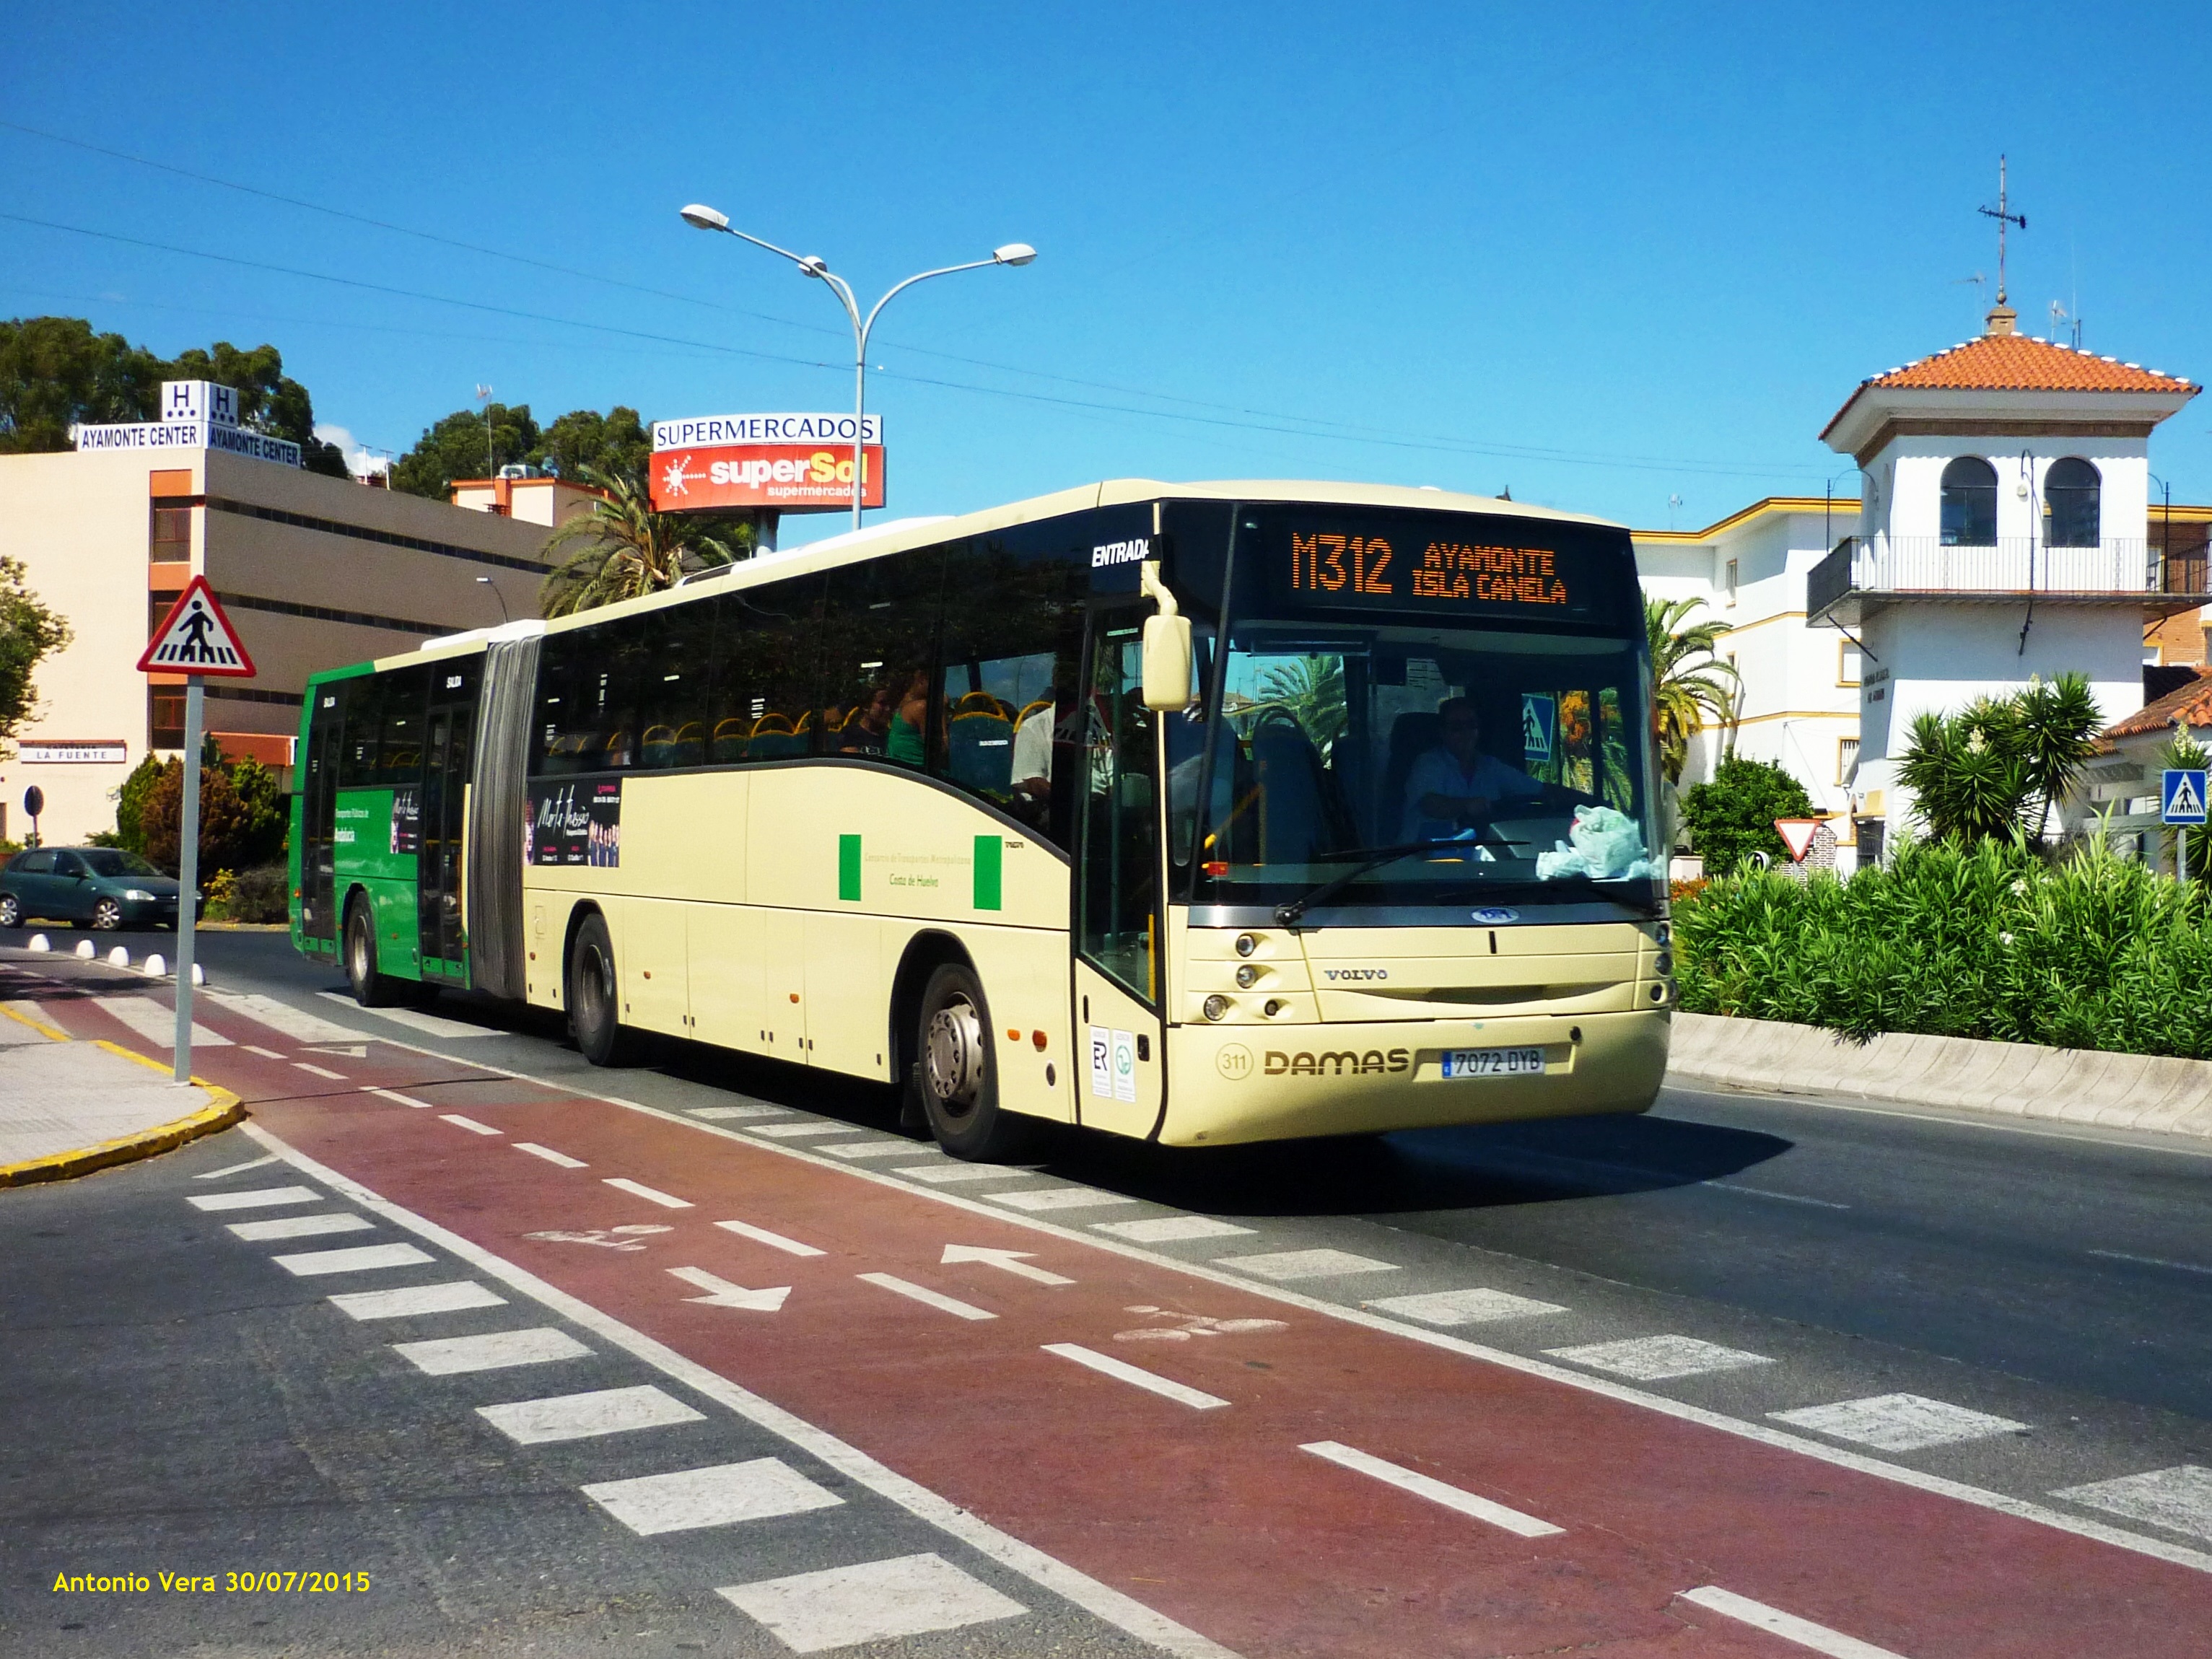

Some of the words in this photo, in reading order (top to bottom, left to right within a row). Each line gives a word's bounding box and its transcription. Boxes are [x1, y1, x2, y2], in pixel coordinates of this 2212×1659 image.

[174, 385, 189, 407] H
[217, 387, 229, 413] H
[82, 428, 144, 449] AYAMONTE
[150, 425, 197, 446] CENTER
[210, 426, 260, 456] AYAMONTE
[262, 443, 298, 465] CENTER
[657, 419, 873, 446] SUPERMERCADOS
[1292, 533, 1393, 594] M312
[1424, 542, 1555, 575] AYAMONTE
[1412, 569, 1469, 598] ISLA
[1476, 574, 1567, 604] CANELA
[1324, 969, 1388, 981] VOLVO
[1223, 1053, 1246, 1069] 311
[1264, 1049, 1409, 1075] DAMAS
[1455, 1051, 1502, 1074] 7072
[1508, 1050, 1539, 1072] DYB
